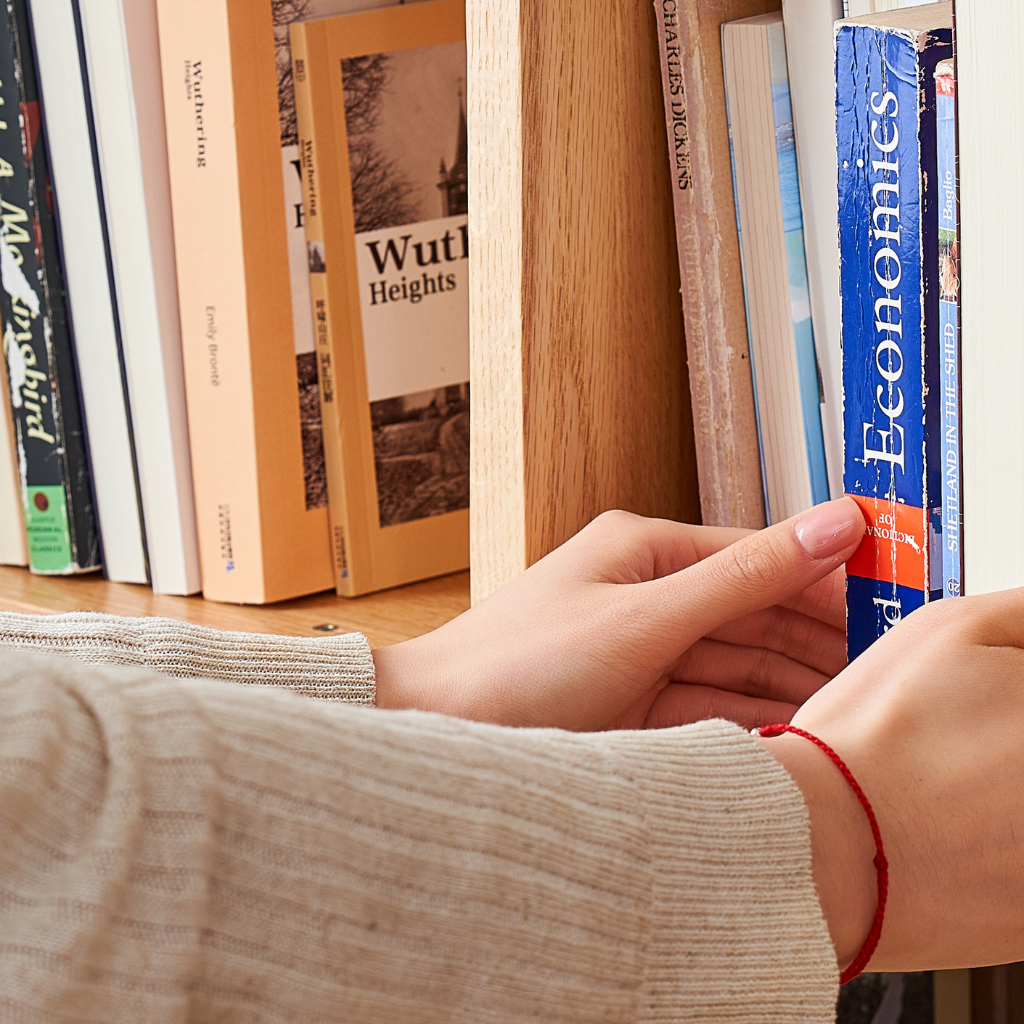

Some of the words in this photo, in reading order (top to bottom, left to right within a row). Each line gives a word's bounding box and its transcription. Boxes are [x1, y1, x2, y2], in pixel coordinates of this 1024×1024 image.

[192, 60, 206, 168] Wuthering
[671, 102, 692, 190] DICKENS
[942, 170, 953, 221] Baglio
[368, 272, 457, 306] Heights
[863, 90, 905, 475] Economics
[206, 305, 216, 341] Emily
[944, 323, 956, 375] SHED
[945, 380, 957, 418] THE
[945, 426, 957, 444] IN
[879, 513, 893, 525] OF
[946, 456, 959, 552] SHETLAND
[865, 525, 915, 544] DICTIONA
